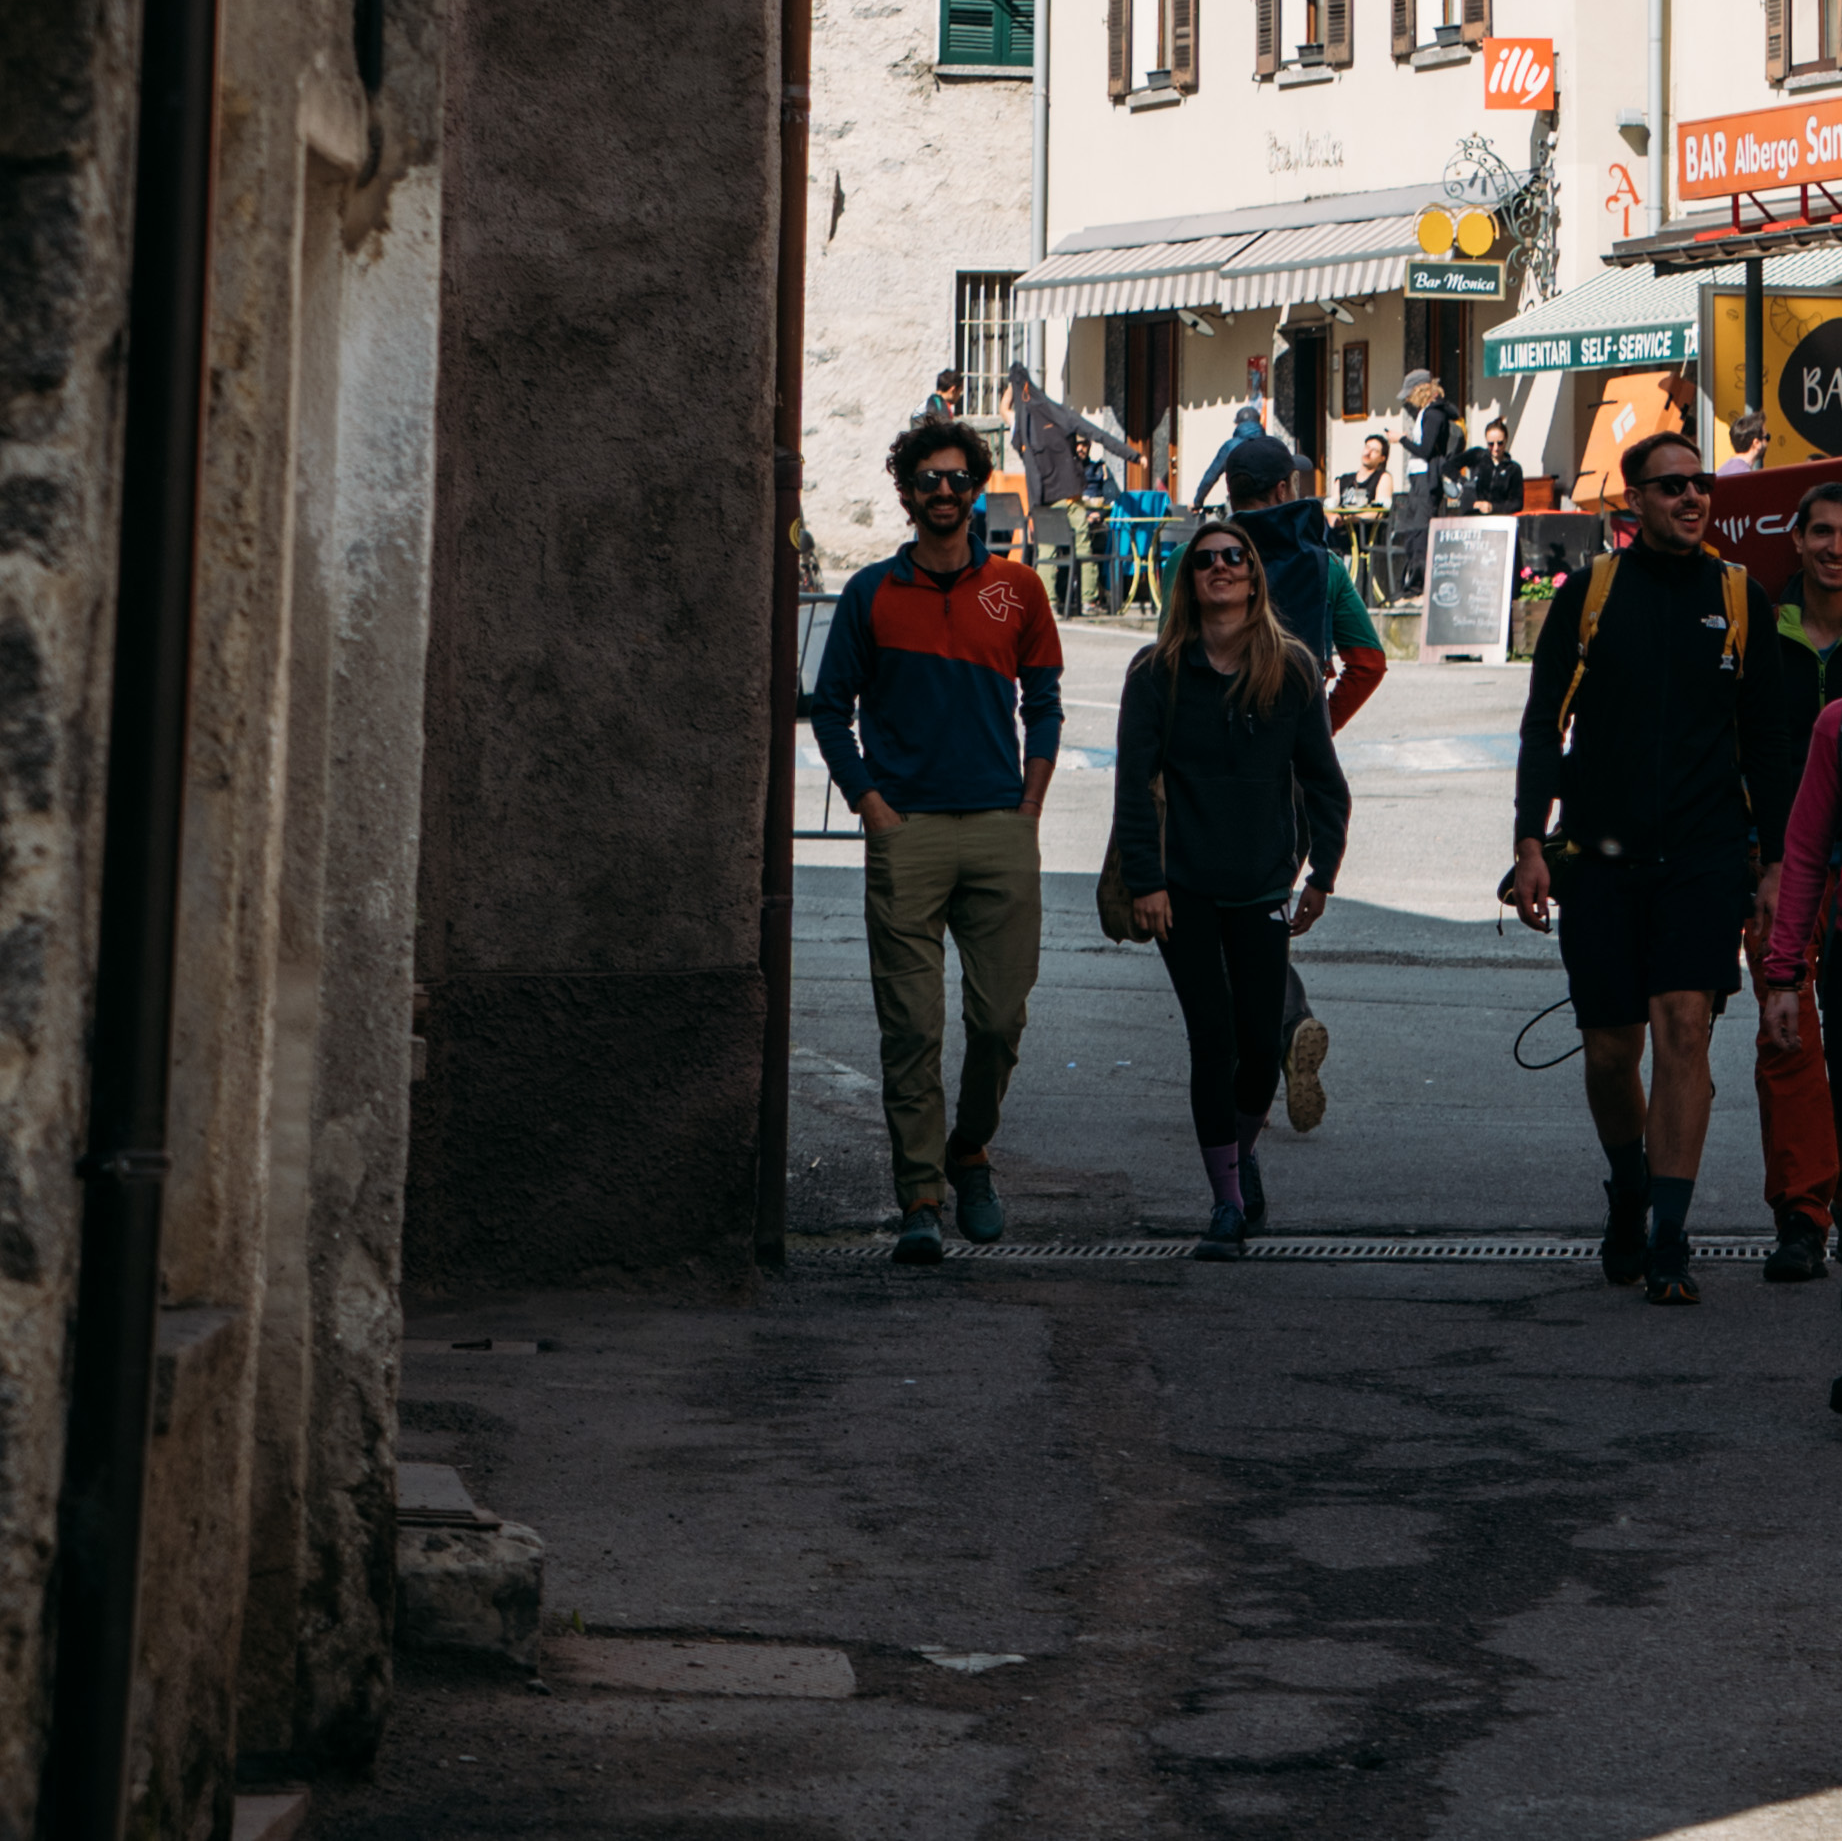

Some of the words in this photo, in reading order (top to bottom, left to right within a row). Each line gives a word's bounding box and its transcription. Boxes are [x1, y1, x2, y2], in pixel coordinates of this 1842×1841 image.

[1488, 46, 1551, 105] illy
[1685, 131, 1727, 183] BAR
[1734, 133, 1799, 180] Albergo
[1413, 271, 1441, 289] Bar
[1443, 272, 1496, 292] Monica
[1499, 339, 1572, 371] ALIMENTARI
